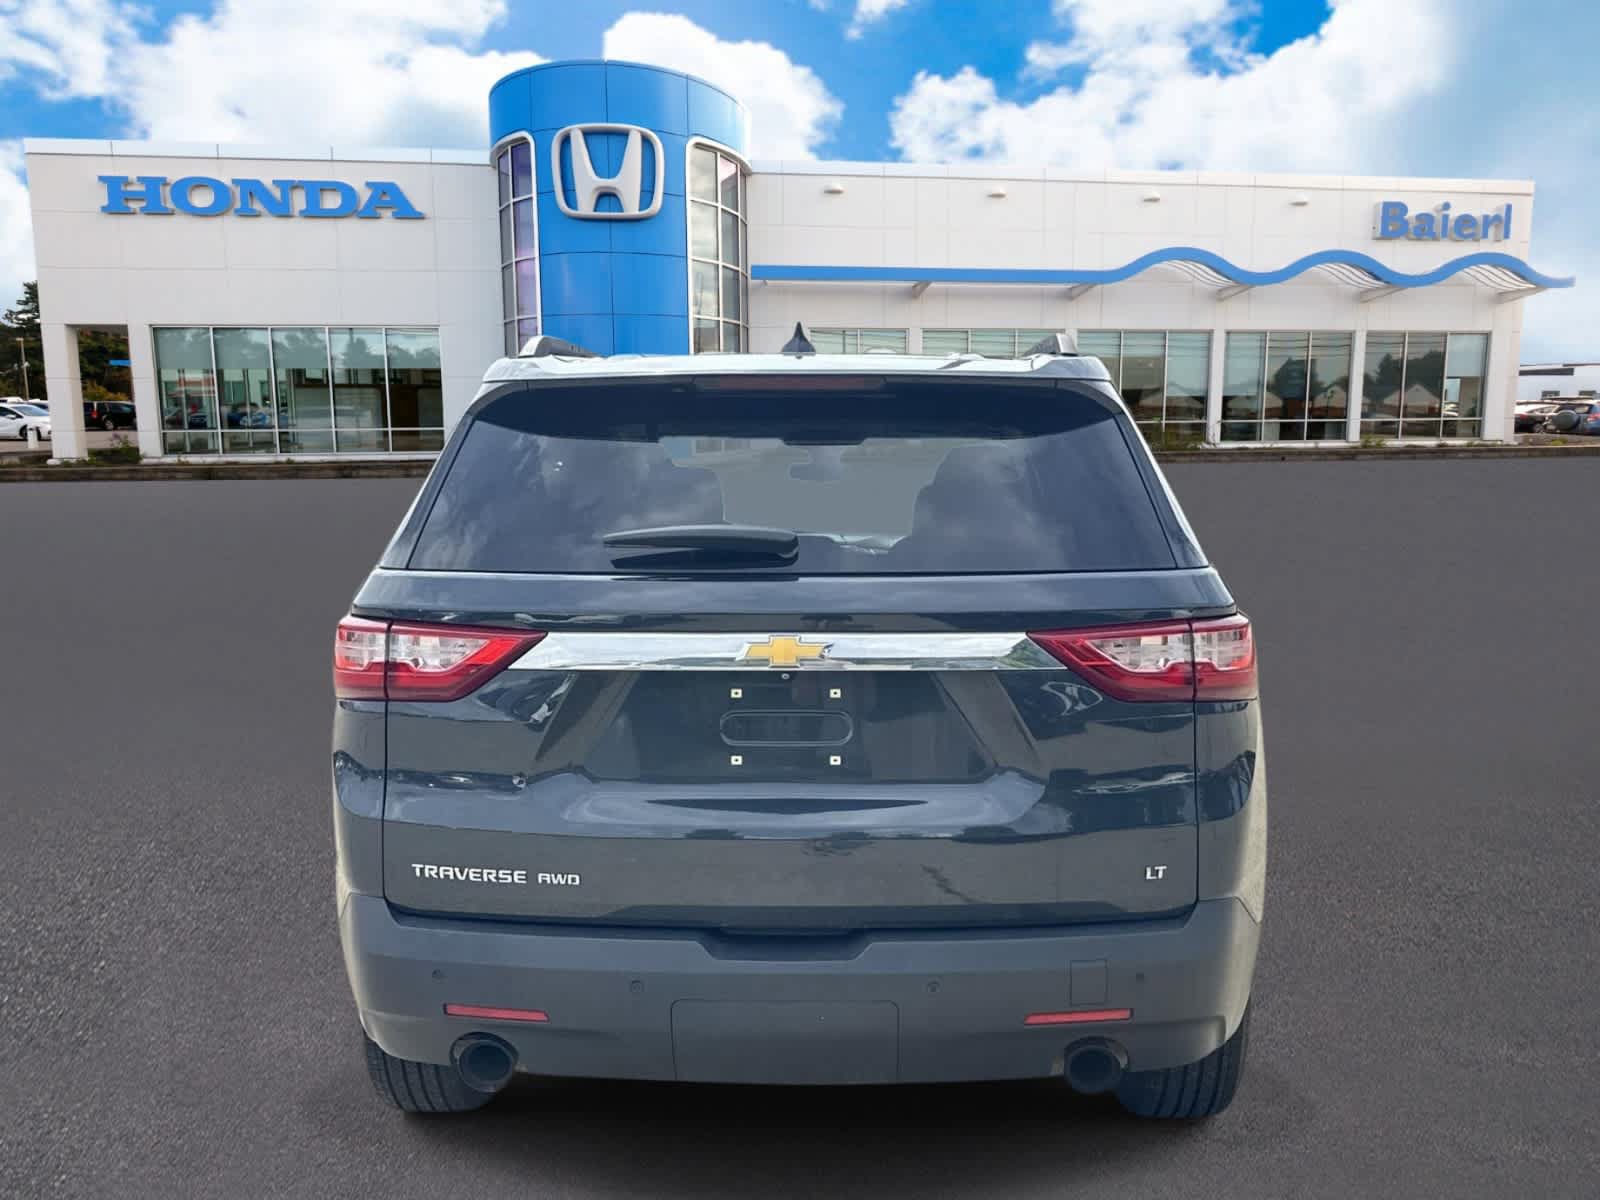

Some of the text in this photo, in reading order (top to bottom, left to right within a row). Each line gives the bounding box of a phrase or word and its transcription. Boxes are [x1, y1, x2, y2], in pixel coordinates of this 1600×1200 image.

[98, 175, 426, 219] HONDA
[1377, 201, 1513, 240] Baierl
[411, 863, 581, 886] TRAVERSE AWD
[1146, 866, 1168, 880] LT
